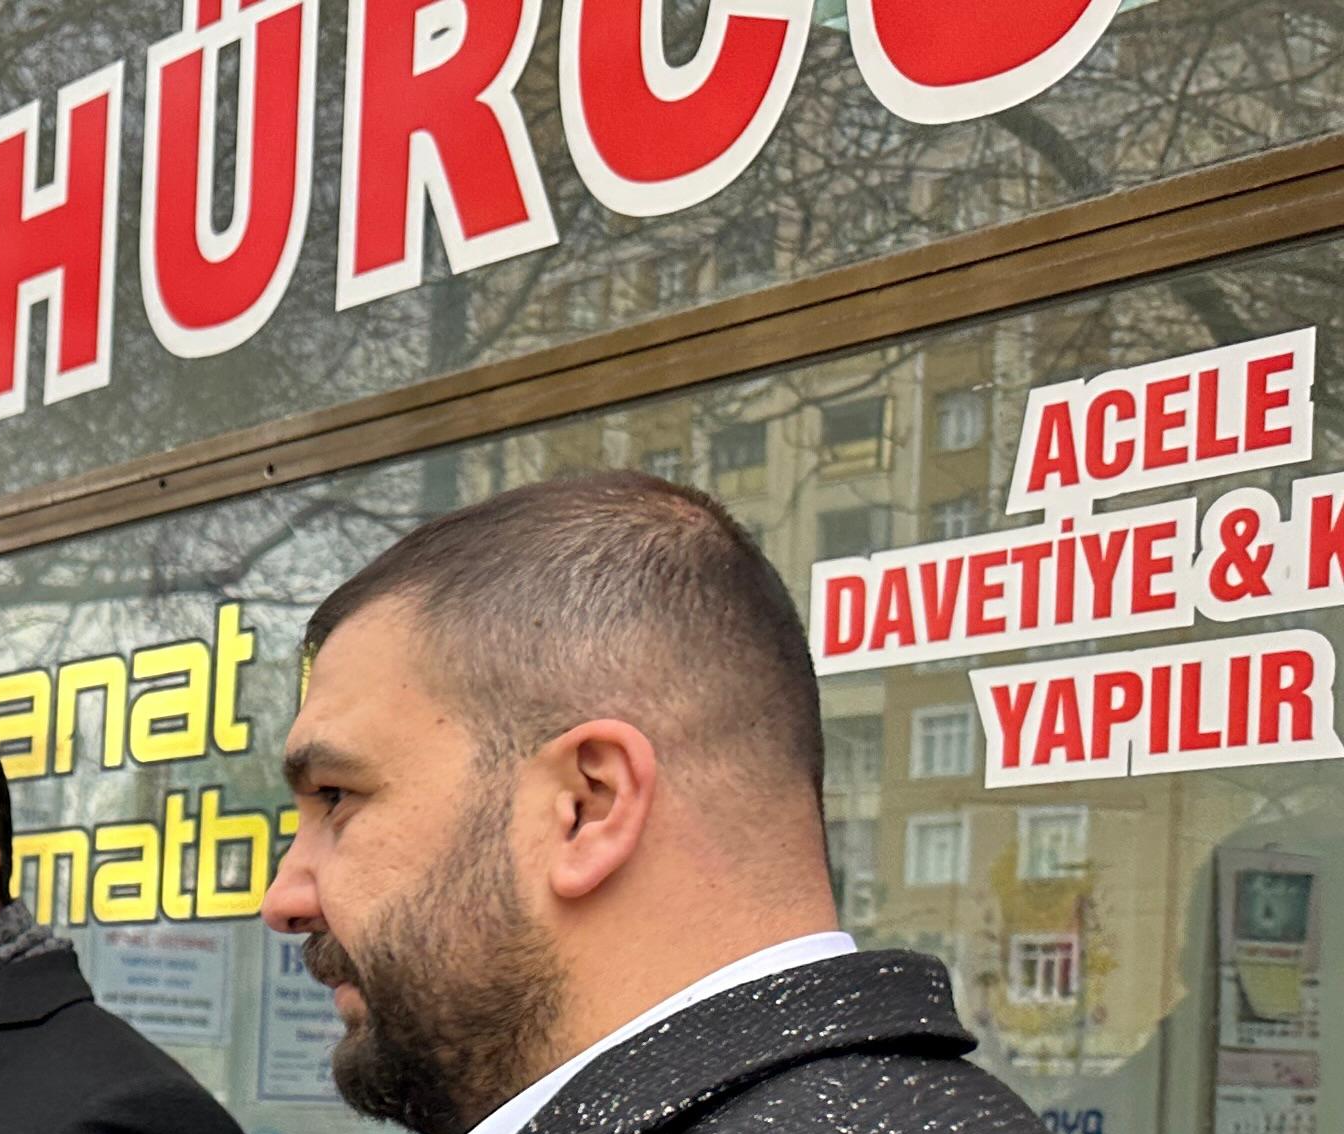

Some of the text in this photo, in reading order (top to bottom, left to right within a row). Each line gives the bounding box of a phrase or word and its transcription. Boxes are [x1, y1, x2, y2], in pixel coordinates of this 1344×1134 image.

[1025, 351, 1296, 495] ACELE
[822, 517, 1179, 659] DAVETİYE
[1208, 507, 1274, 604] &
[990, 649, 1315, 770] YAPILIR
